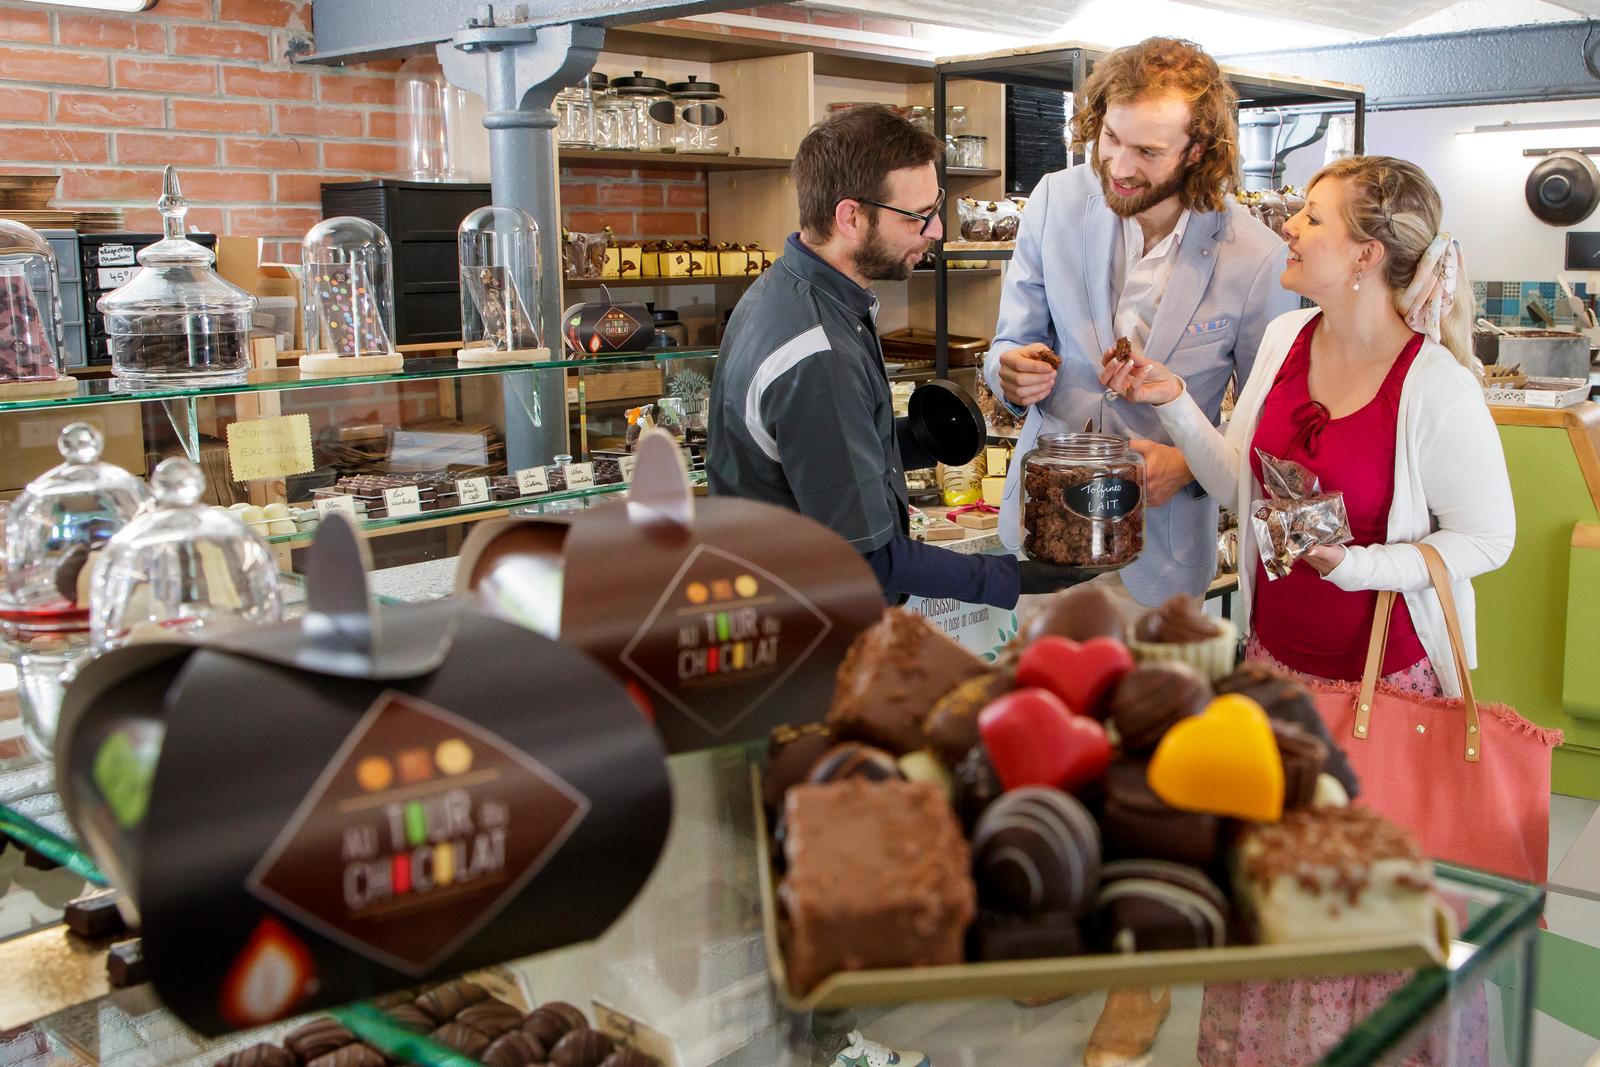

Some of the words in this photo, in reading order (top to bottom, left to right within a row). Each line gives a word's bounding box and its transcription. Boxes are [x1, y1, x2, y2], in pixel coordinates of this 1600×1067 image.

[704, 606, 758, 644] TOUR
[677, 637, 779, 681] CHOCOLAT
[382, 788, 474, 850] TOUR
[342, 829, 507, 908] CHOCOLAT
